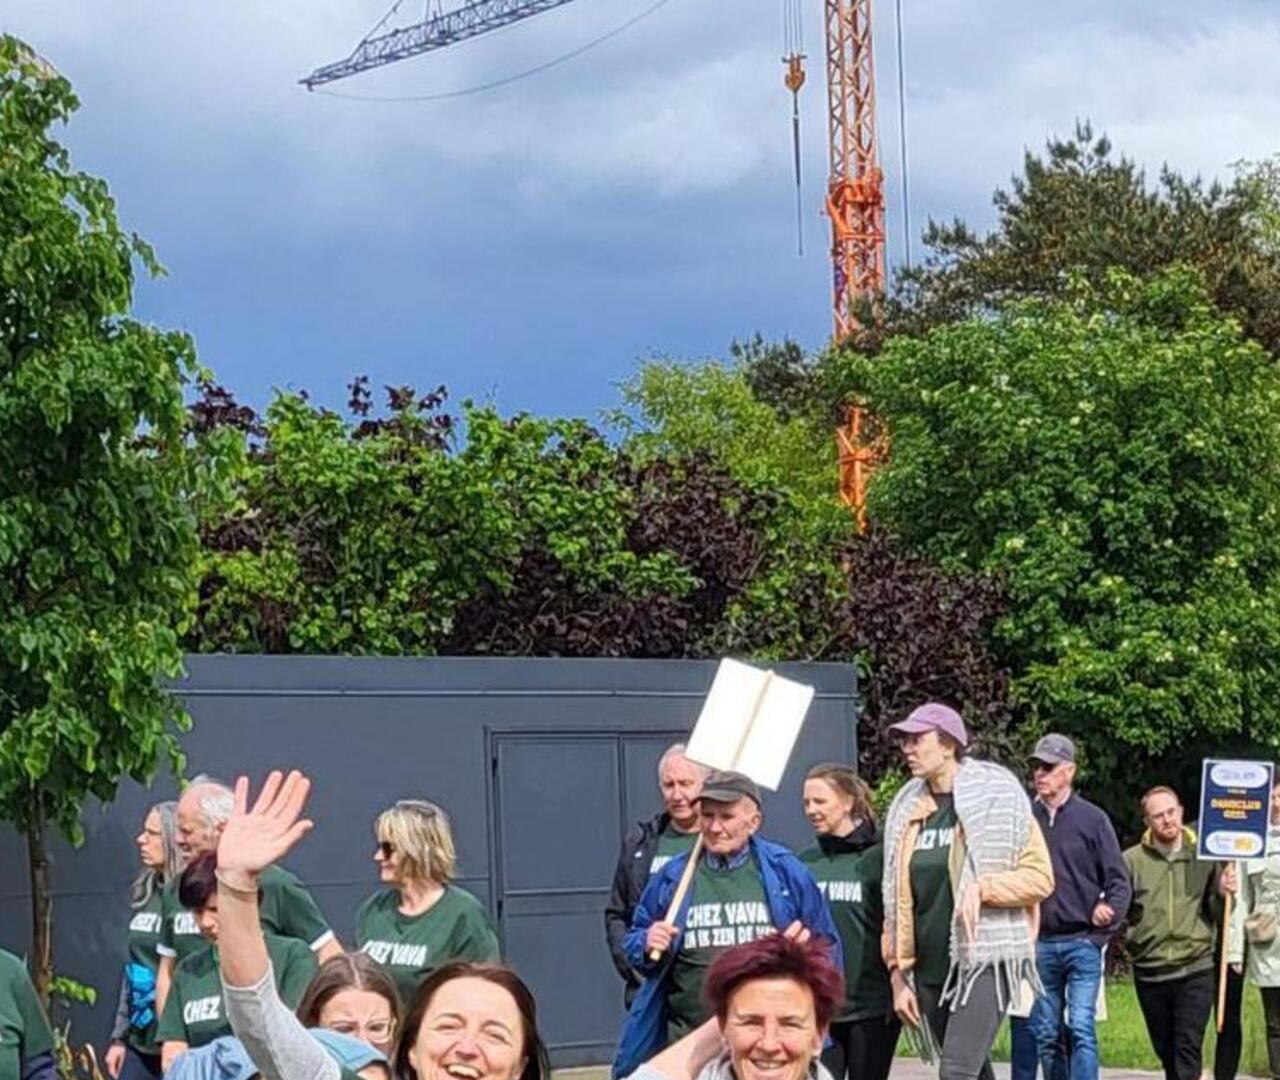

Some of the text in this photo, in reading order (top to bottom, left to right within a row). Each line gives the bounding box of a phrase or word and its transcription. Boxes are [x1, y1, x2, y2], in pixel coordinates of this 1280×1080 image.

[828, 880, 862, 902] VAVA
[174, 911, 201, 935] CHE
[686, 902, 769, 929] CHEZ VAVA
[390, 942, 427, 968] VAVA
[183, 996, 221, 1025] CHEZ
